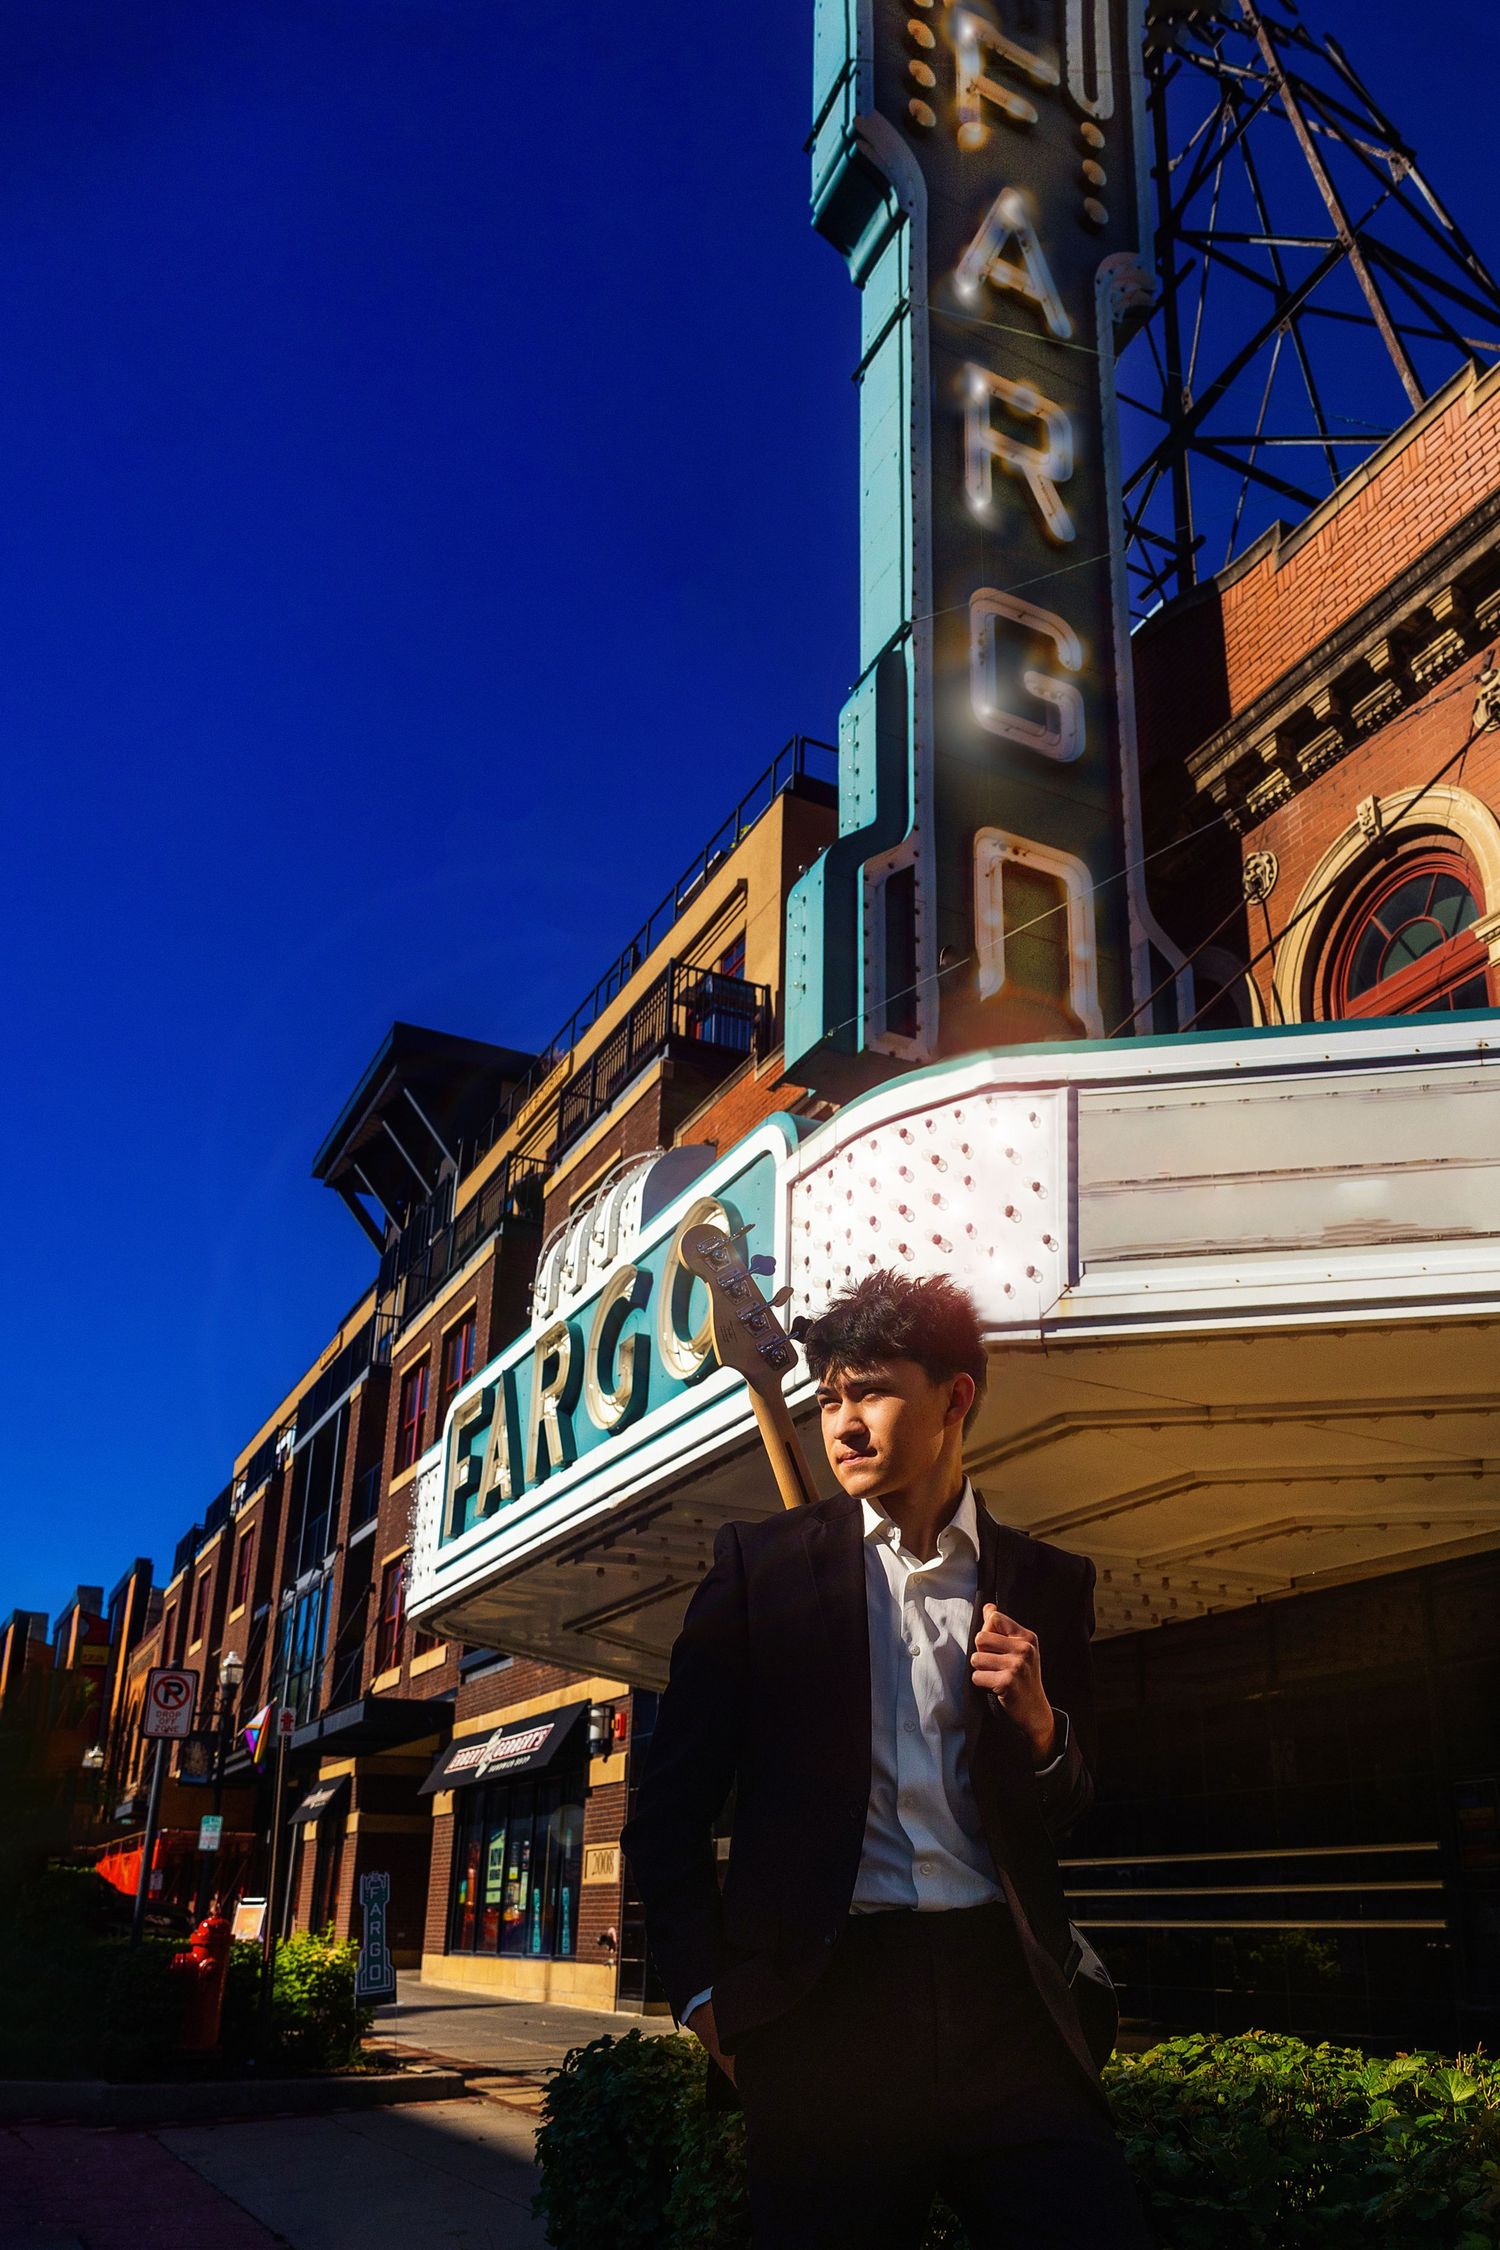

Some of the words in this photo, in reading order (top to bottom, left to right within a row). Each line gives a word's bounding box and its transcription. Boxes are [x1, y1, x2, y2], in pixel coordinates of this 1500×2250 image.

[954, 5, 1104, 1038] FARGO
[443, 1195, 742, 1538] FARGO
[155, 1710, 182, 1718] DROP
[159, 1717, 176, 1725] OFF
[154, 1724, 180, 1733] ZONE
[592, 1850, 615, 1875] 2008
[369, 1885, 383, 1981] FARGO
